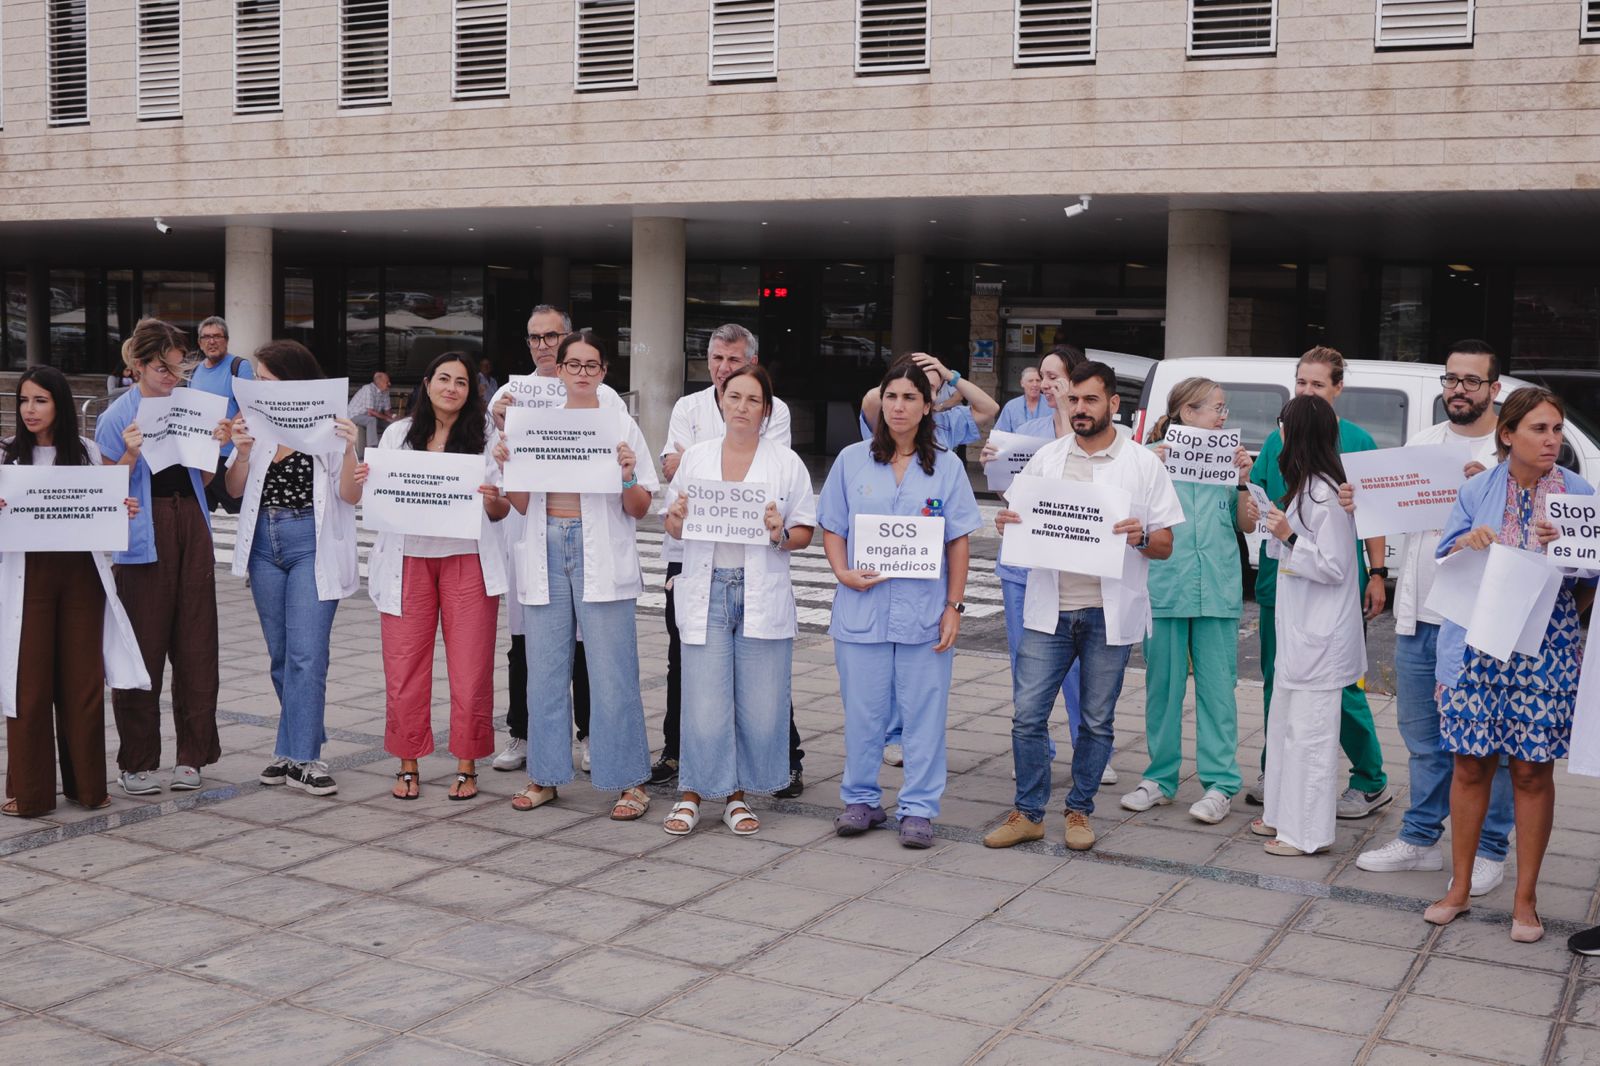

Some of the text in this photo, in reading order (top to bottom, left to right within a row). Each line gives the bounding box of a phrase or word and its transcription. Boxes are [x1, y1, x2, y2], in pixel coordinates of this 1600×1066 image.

[510, 380, 567, 397] Stop SC
[188, 427, 212, 436] ANTES
[1166, 430, 1239, 449] Stop SCS
[1169, 448, 1232, 463] la OPE no
[1180, 466, 1196, 476] un
[1199, 468, 1236, 481] juego
[1362, 479, 1431, 490] NOMBRAMIENTOS
[374, 489, 447, 498] ¡NOMBRAMIENTOS
[687, 484, 766, 503] Stop SCS
[406, 498, 451, 506] EXAMINAR!
[1053, 502, 1079, 511] LISTAS
[1398, 497, 1457, 507] ENTENDIMIEN
[693, 504, 759, 520] la OPE no
[1032, 508, 1104, 522] NOMBRAMIENTOS
[1550, 502, 1596, 522] Stop
[686, 523, 764, 538] es un juego
[879, 523, 917, 538] SCS
[1065, 526, 1090, 535] QUEDA
[1258, 523, 1270, 533] lo
[1561, 525, 1600, 538] la OP
[1032, 529, 1100, 544] ENFRENTAMIENTO
[866, 544, 928, 558] engaña a
[1554, 546, 1596, 559] es un
[856, 560, 936, 571] los médicos
